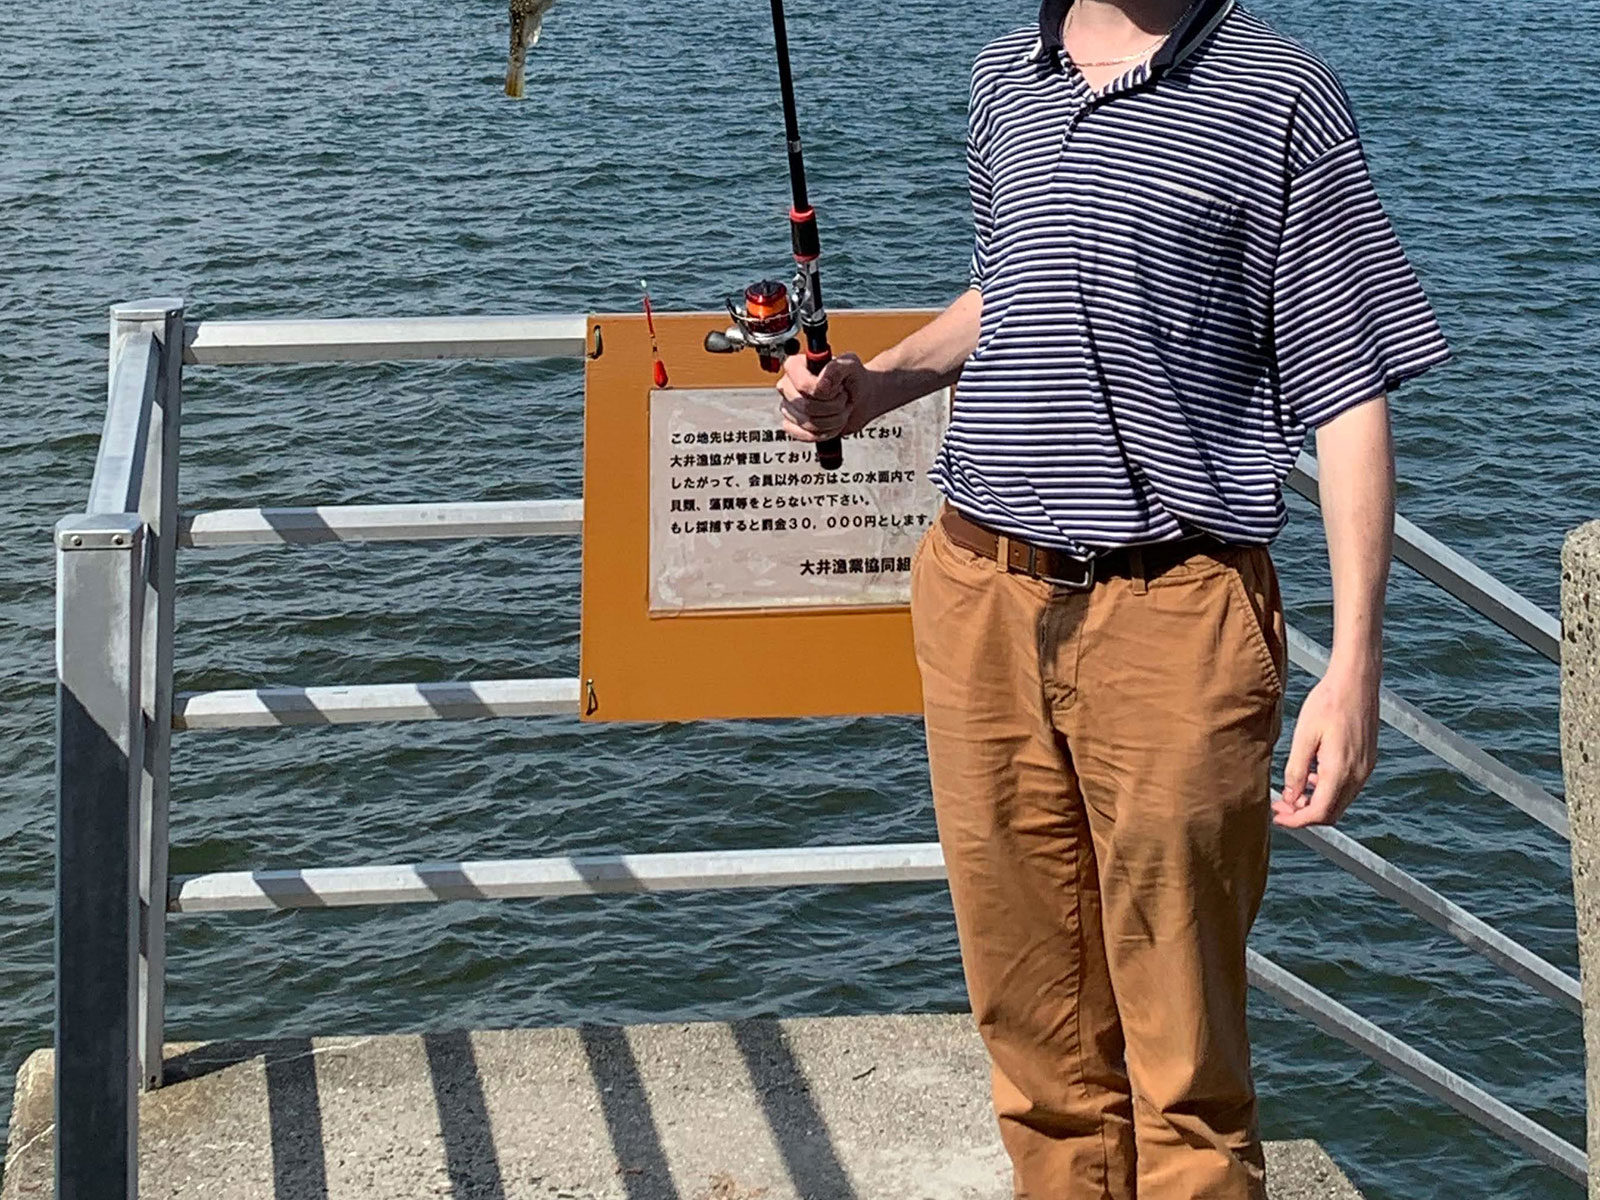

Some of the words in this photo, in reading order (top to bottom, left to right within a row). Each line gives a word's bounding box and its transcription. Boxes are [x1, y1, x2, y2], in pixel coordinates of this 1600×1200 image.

[671, 426, 903, 445] この地先は共同漁業れており
[671, 470, 916, 490] したがって、会員以外の方はこの水面内で
[800, 556, 911, 576] 大井漁業協同組
